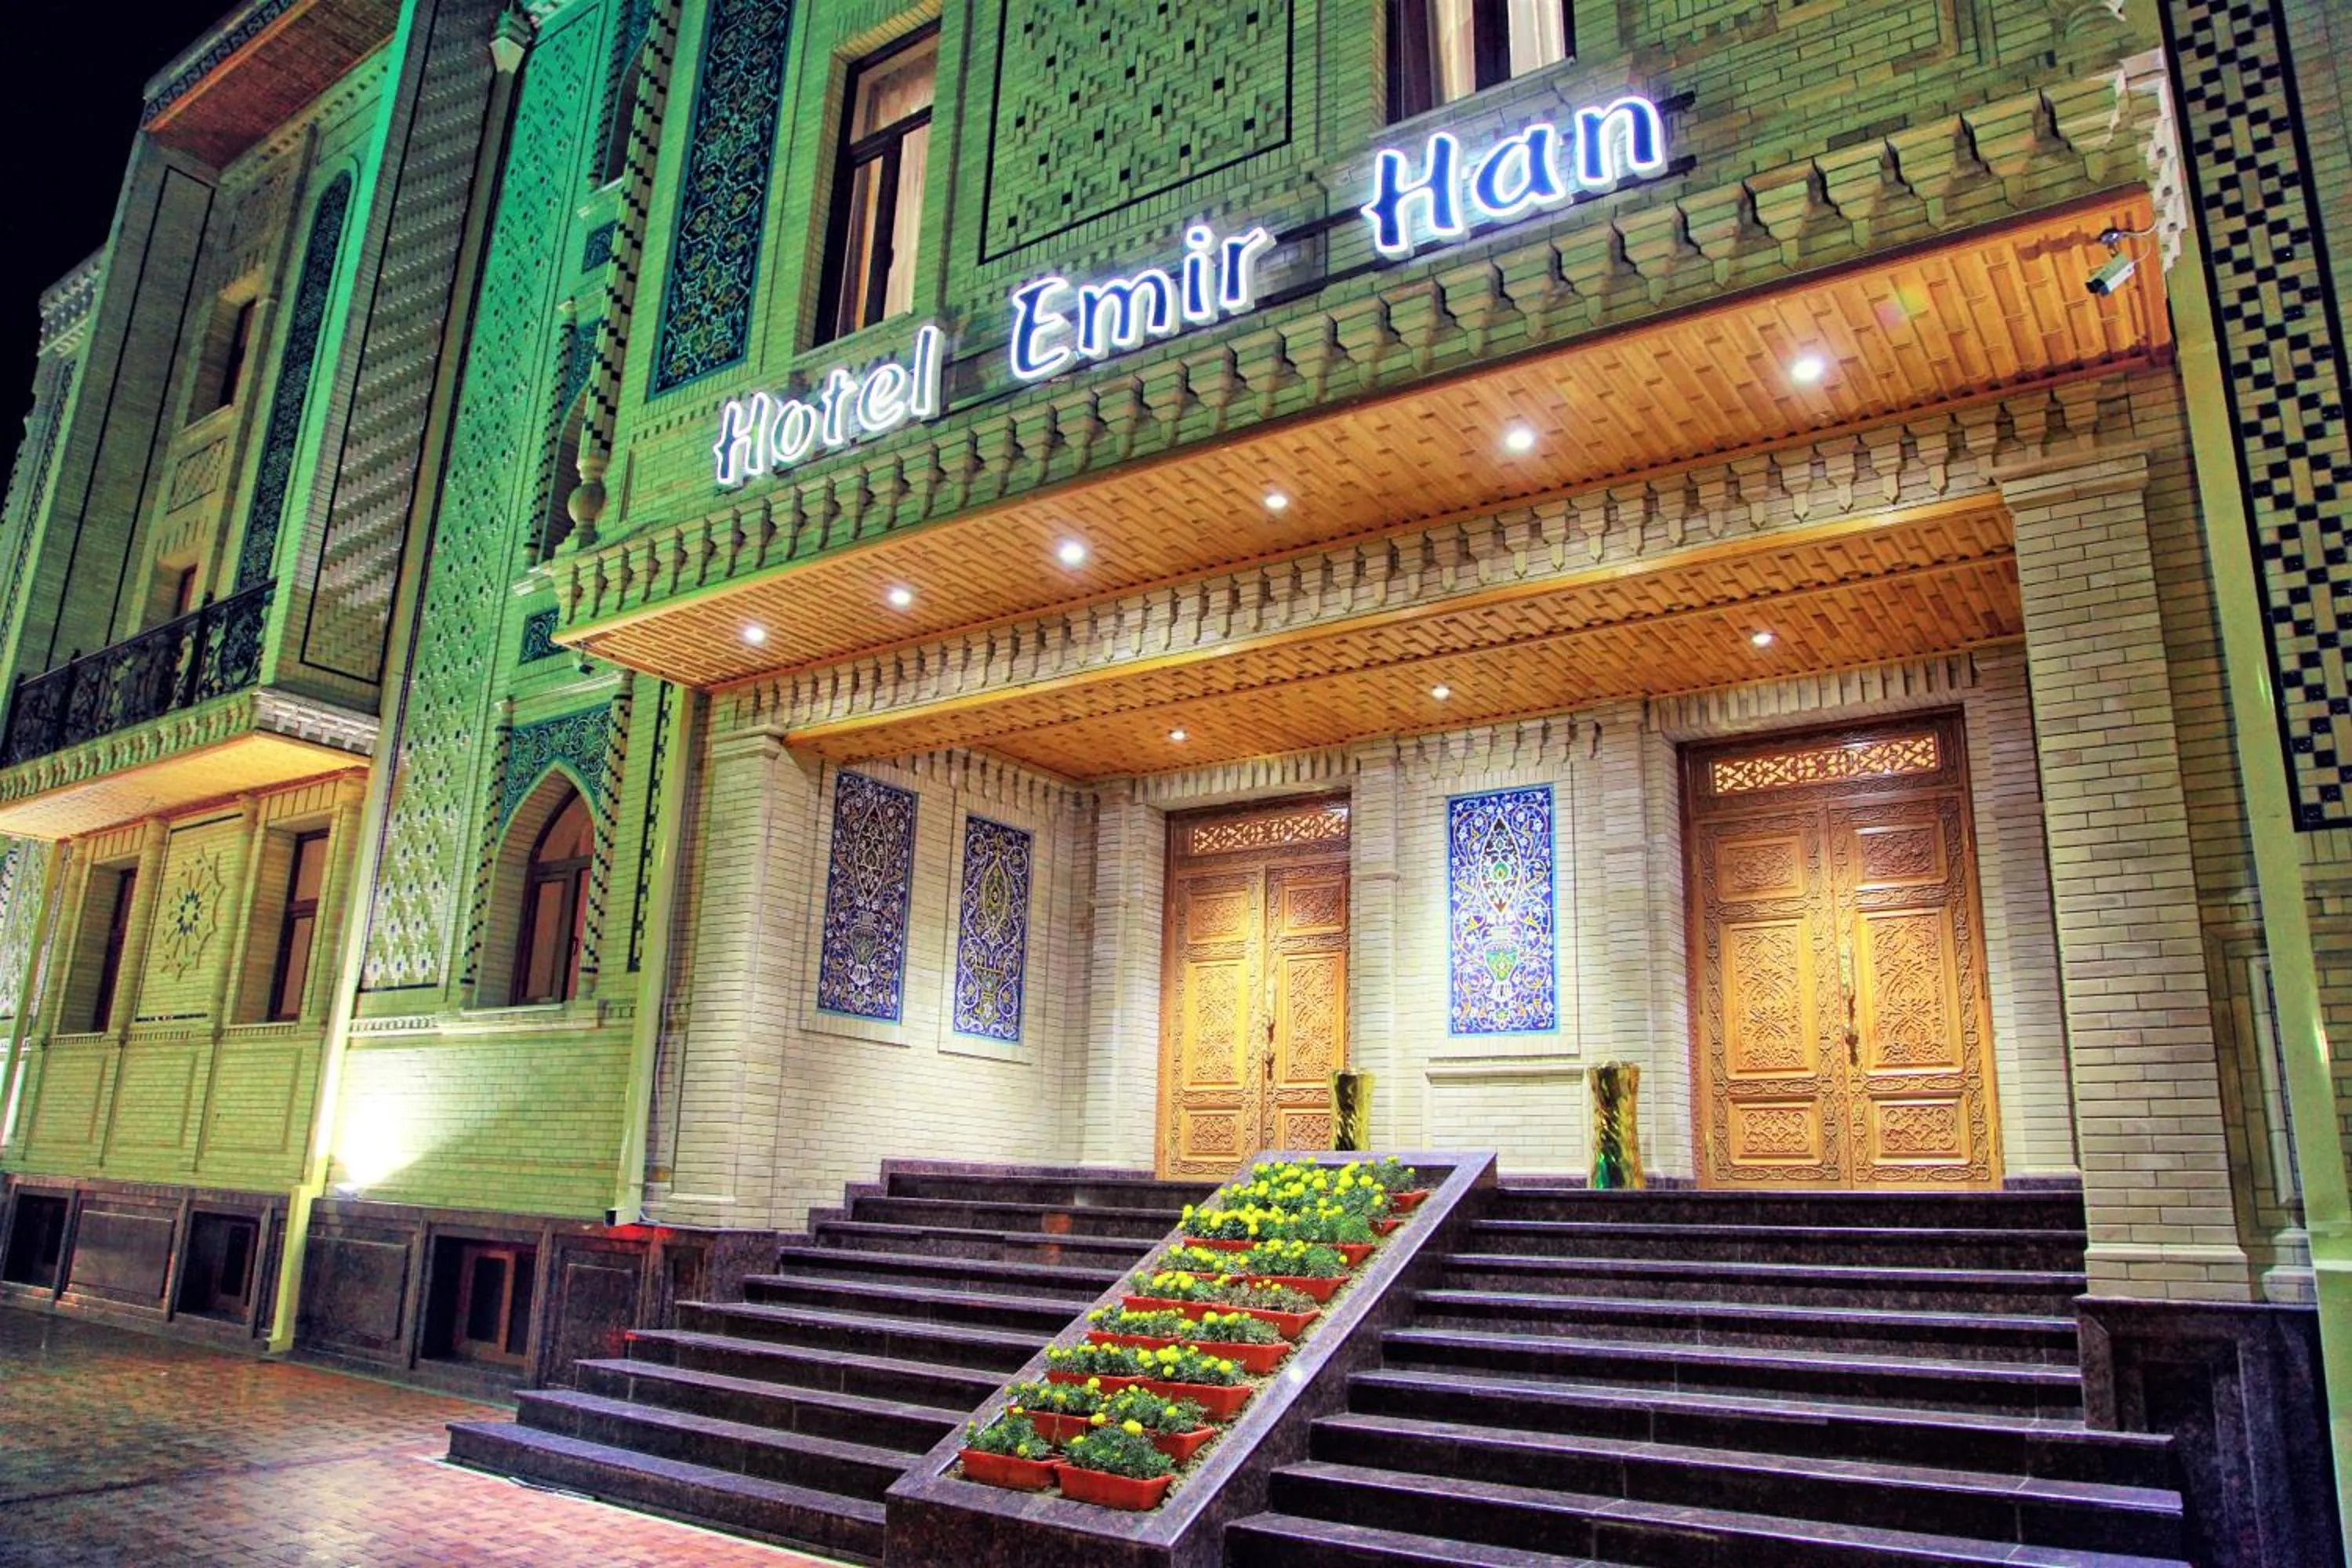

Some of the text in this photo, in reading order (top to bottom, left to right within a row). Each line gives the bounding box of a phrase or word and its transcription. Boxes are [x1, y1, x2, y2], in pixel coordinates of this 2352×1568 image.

[713, 96, 1665, 485] Hotel Emir Han
